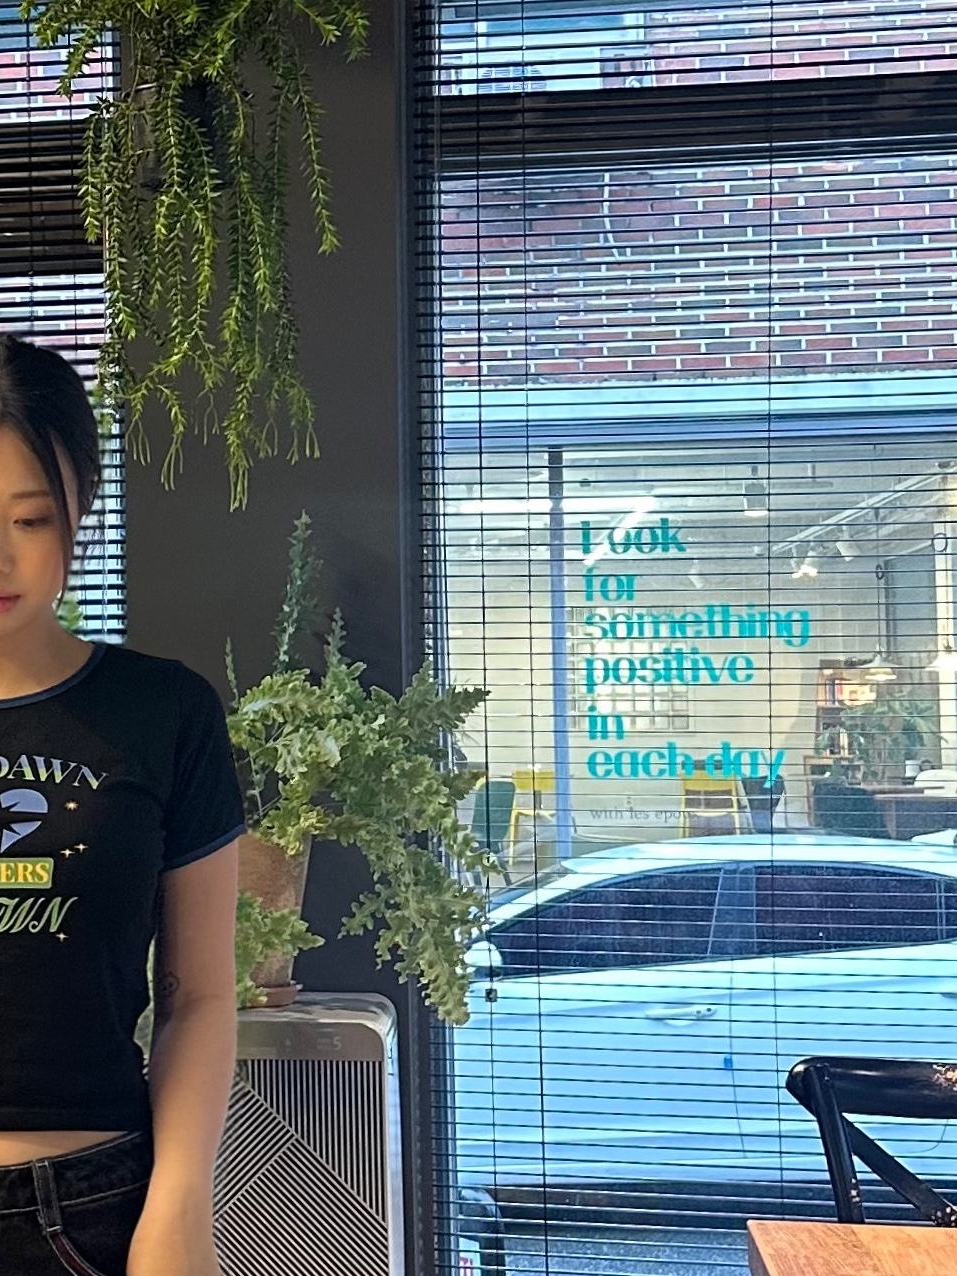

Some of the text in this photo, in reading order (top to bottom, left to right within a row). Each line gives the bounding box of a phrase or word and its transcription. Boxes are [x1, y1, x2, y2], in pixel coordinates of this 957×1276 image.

[580, 517, 687, 555] Look
[583, 566, 637, 602] for
[584, 602, 811, 648] something
[584, 646, 755, 694] positive
[587, 704, 625, 740] in
[587, 740, 786, 789] each day
[590, 806, 624, 820] with
